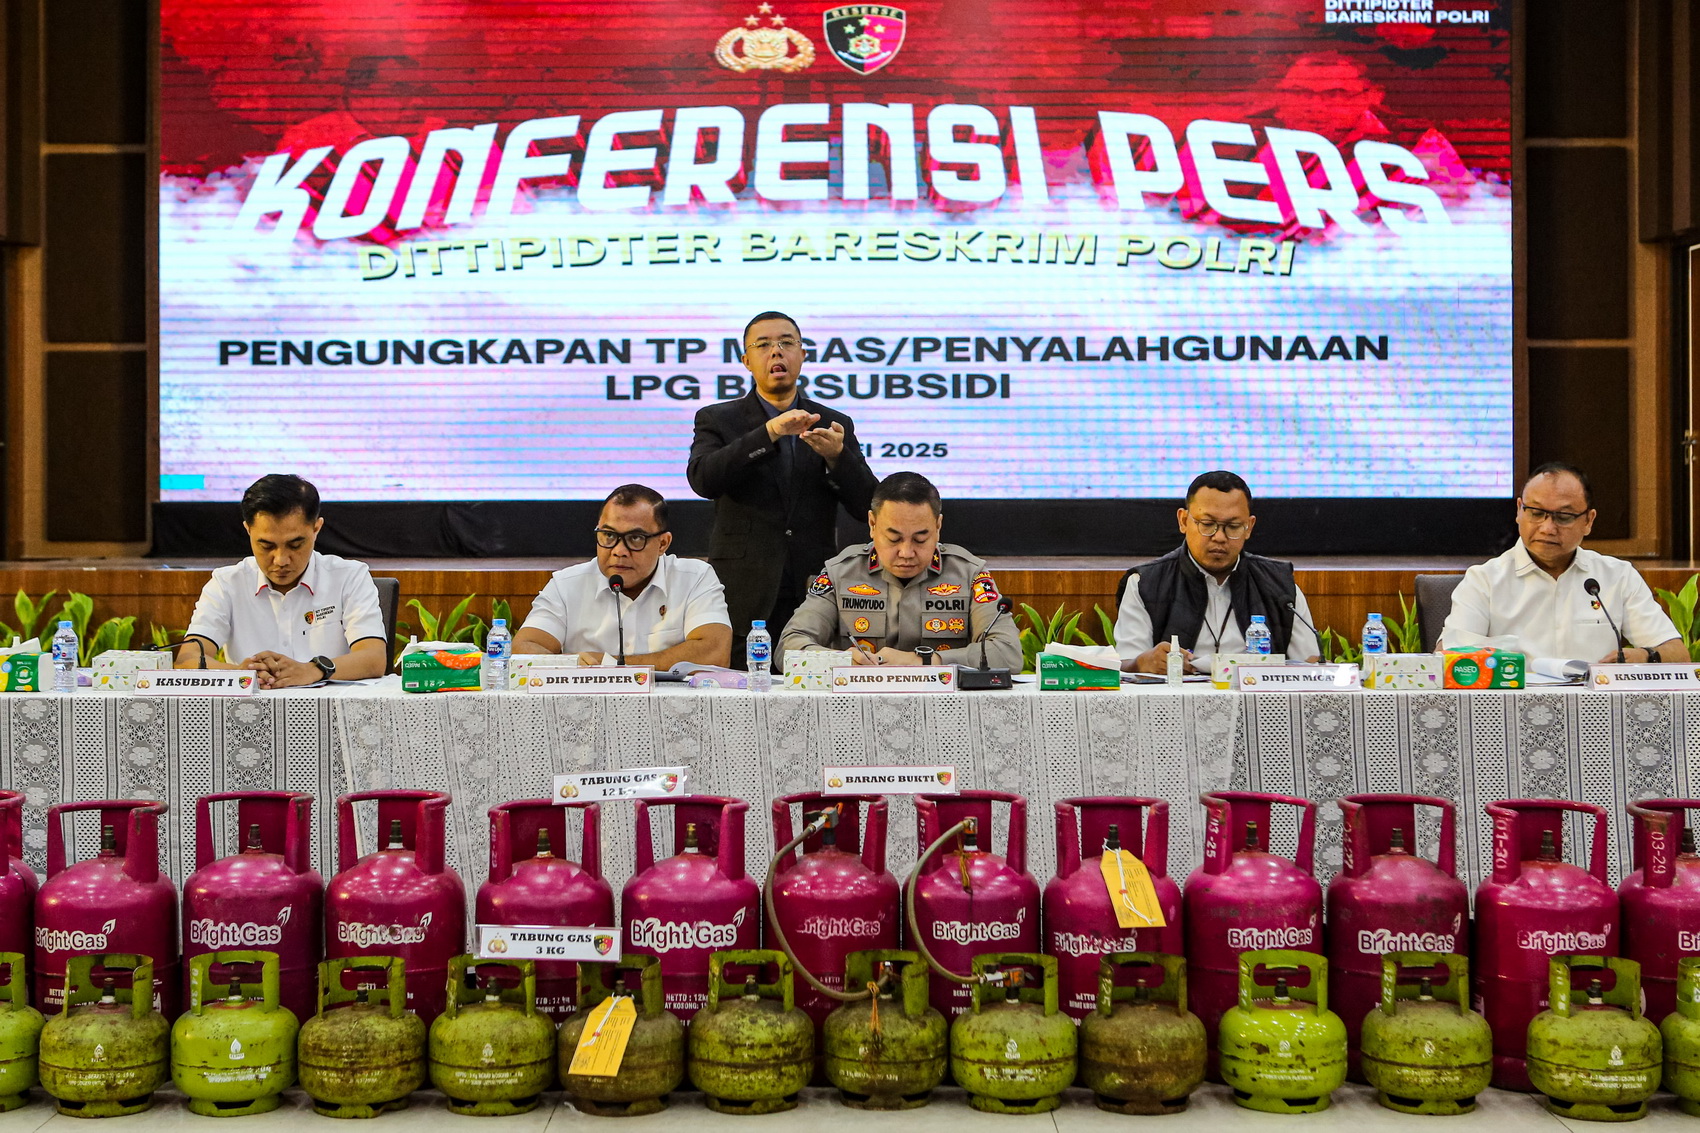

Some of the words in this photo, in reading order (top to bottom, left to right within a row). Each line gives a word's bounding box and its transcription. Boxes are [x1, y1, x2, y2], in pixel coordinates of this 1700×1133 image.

[1325, 0, 1434, 10] DITTIPIDTER
[1325, 11, 1432, 24] BARESKRIM
[1436, 11, 1490, 24] POLRI
[232, 102, 1050, 242] KONFERENSI
[1097, 110, 1455, 238] PERS
[357, 231, 722, 281] DITTIPIDTER
[742, 229, 1099, 265] BARESKRIM
[1116, 234, 1296, 276] POLRI
[219, 339, 631, 366] PENGUNGKAPAN
[646, 338, 707, 364] TP
[606, 375, 700, 400] LPG
[717, 373, 1010, 400] BSUBSIDI
[881, 443, 948, 458] 2025
[842, 598, 885, 610] TRUNOYUDO
[926, 600, 964, 611] POLRI
[156, 678, 225, 687] KASUBDIT
[227, 678, 233, 687] I
[546, 676, 569, 684] DIR
[573, 675, 633, 684] TIPIDTER
[850, 675, 882, 683] KARO
[887, 674, 937, 683] PENMAS
[1262, 674, 1300, 683] DITJEN
[1615, 673, 1671, 681] KASUBDIT
[1675, 673, 1688, 681] III
[580, 775, 631, 786] TABUNG
[634, 773, 658, 782] GAS
[845, 775, 895, 784] BARANG
[898, 775, 934, 783] BUKTI
[602, 788, 616, 797] 12
[1651, 831, 1665, 875] 03-29
[191, 920, 240, 949] Bright
[240, 922, 281, 946] Gas
[804, 918, 849, 939] right
[849, 918, 881, 936] Gas
[933, 921, 988, 945] Bright
[988, 921, 1020, 940] Gas
[36, 927, 70, 953] Bright
[70, 931, 107, 950] Gas
[511, 933, 564, 942] TABUNG
[567, 934, 592, 942] GAS
[632, 918, 693, 953] Bright
[692, 920, 737, 948] Gas
[1228, 928, 1285, 950] Bright
[1284, 927, 1313, 946] Gas
[1358, 929, 1420, 954] Bright
[1420, 933, 1455, 953] Gas
[1518, 931, 1575, 954] Bright
[1575, 931, 1606, 950] Gas
[536, 946, 543, 954] 3
[666, 993, 688, 1002] NETTO
